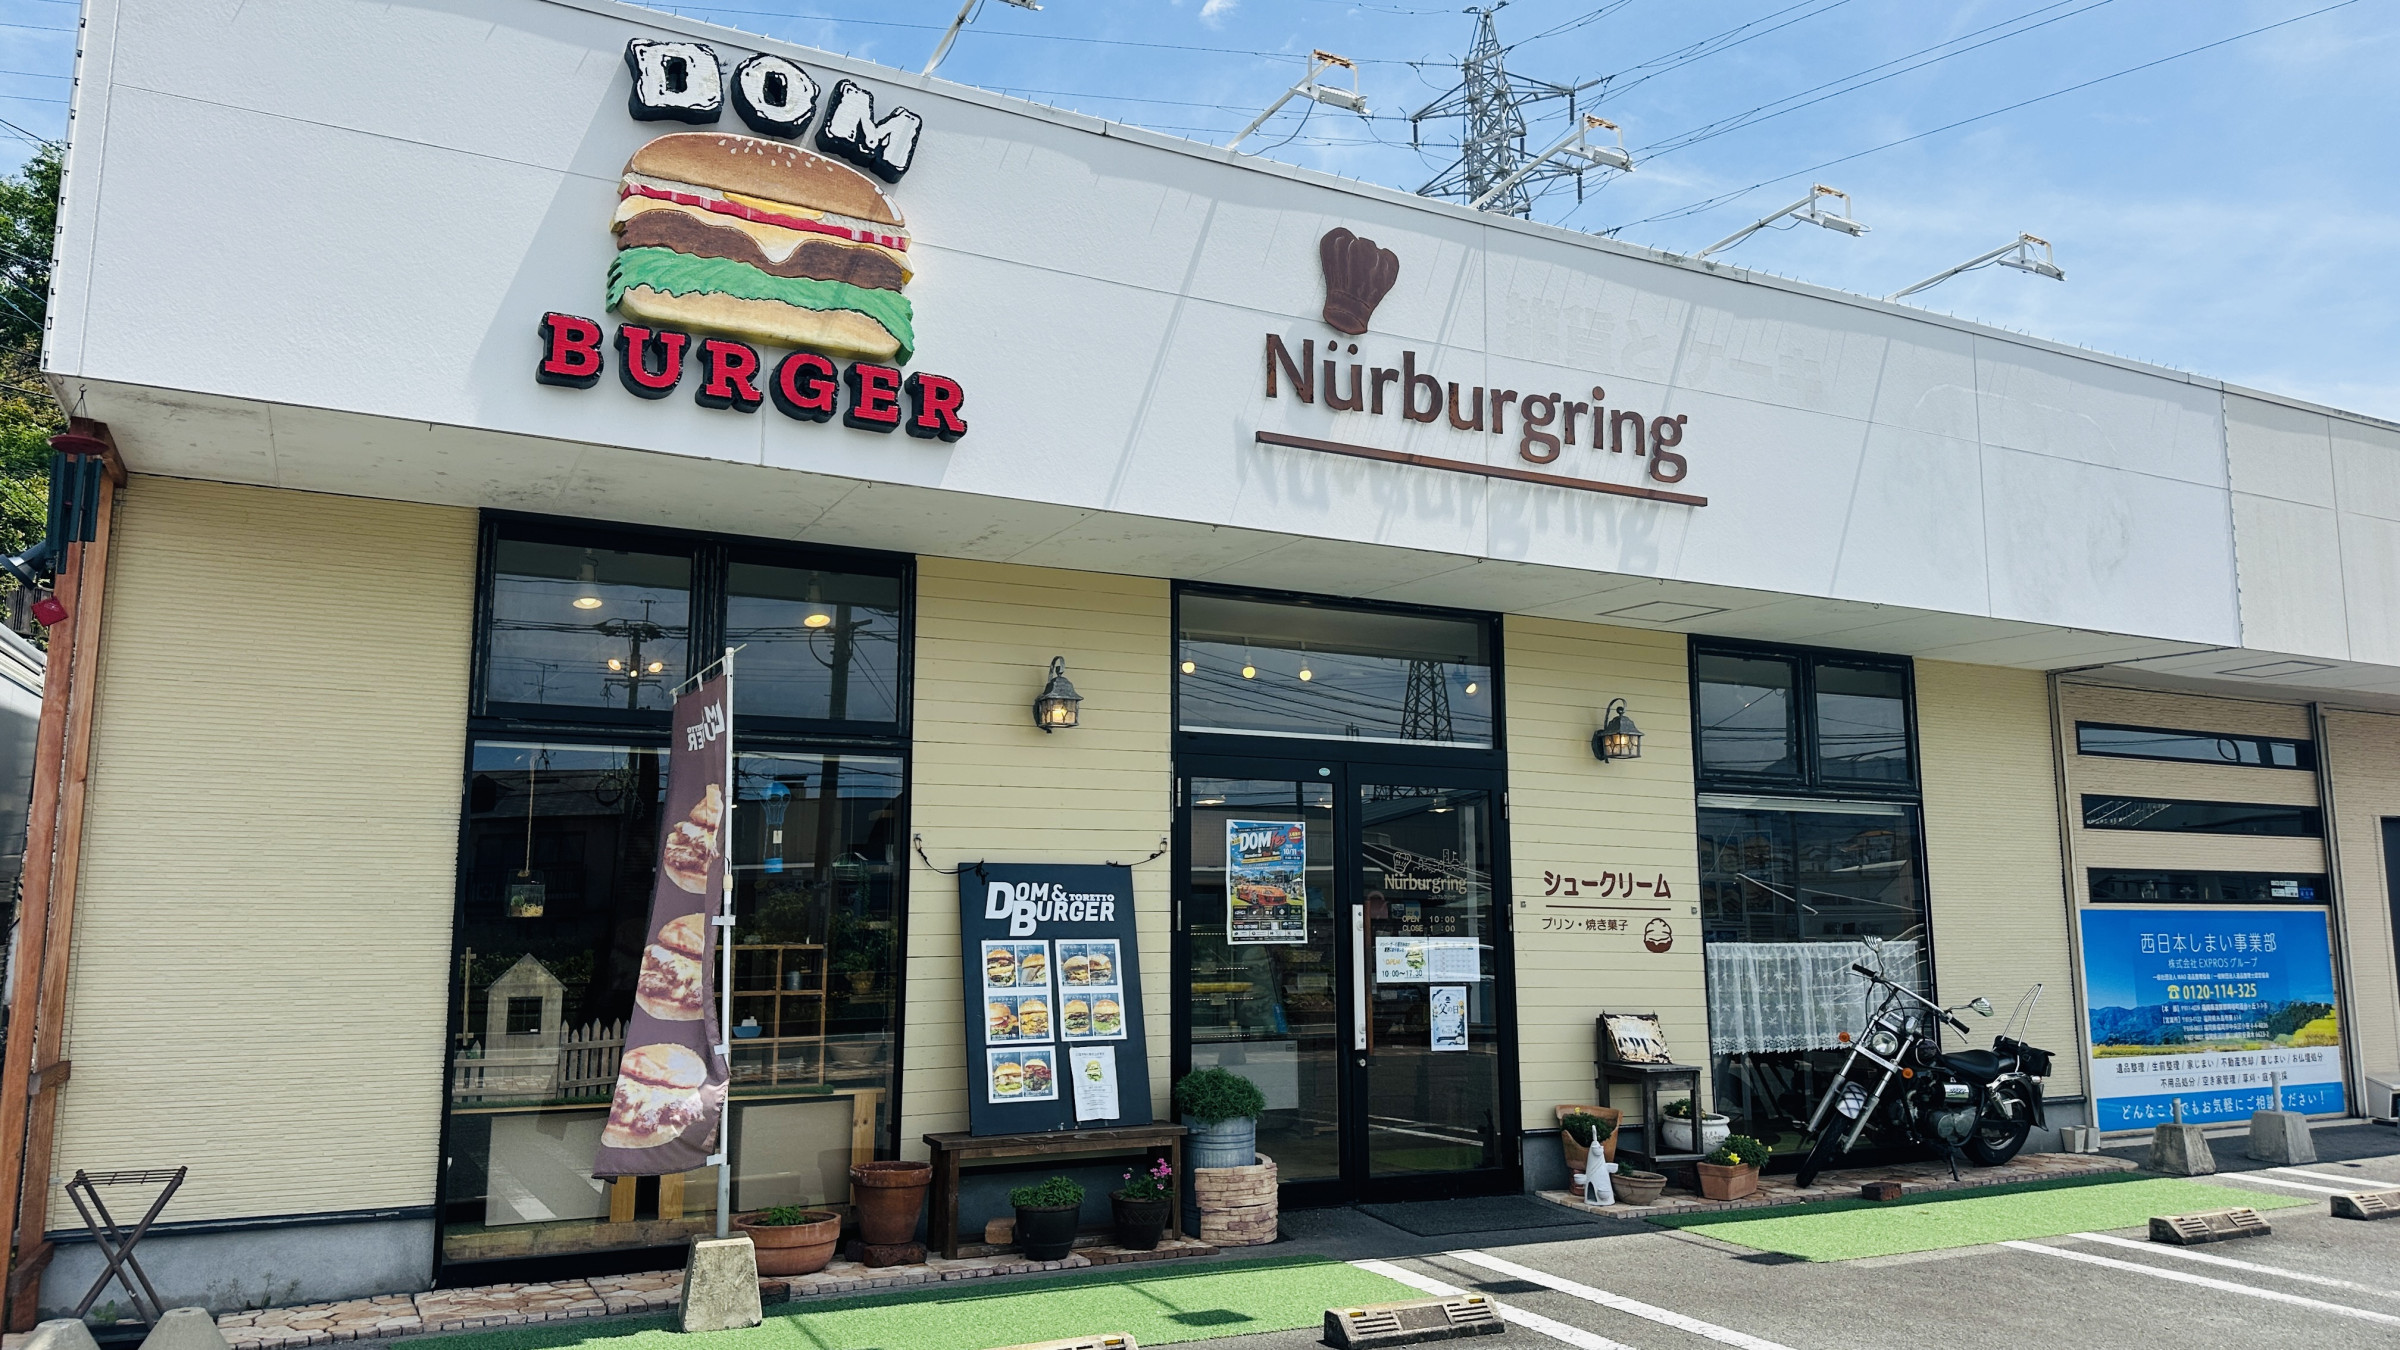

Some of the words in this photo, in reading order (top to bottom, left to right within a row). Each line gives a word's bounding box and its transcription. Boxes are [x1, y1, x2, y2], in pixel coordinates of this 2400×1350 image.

[625, 37, 923, 183] DOM
[536, 311, 968, 443] BURGER
[1265, 332, 1688, 484] Nürburgring
[1240, 830, 1272, 851] DOM
[1384, 873, 1467, 894] Nürburgring
[1543, 870, 1672, 899] シュークリーム
[985, 882, 1049, 919] DOM
[1069, 893, 1115, 902] TORETTO
[1009, 899, 1115, 936] BURGER
[1402, 915, 1420, 923] OPEN
[1429, 915, 1456, 923] 10:00
[1402, 924, 1424, 932] CLOSE
[1542, 917, 1629, 931] プリン・焼き菓子
[2140, 932, 2277, 953] 西日本しまい事業部
[2168, 958, 2197, 969] 株式会社
[2199, 957, 2228, 968] EXPROS
[2230, 956, 2258, 968] グループ
[2183, 983, 2257, 999] 0120-114-325
[1438, 1002, 1459, 1015] 父の日
